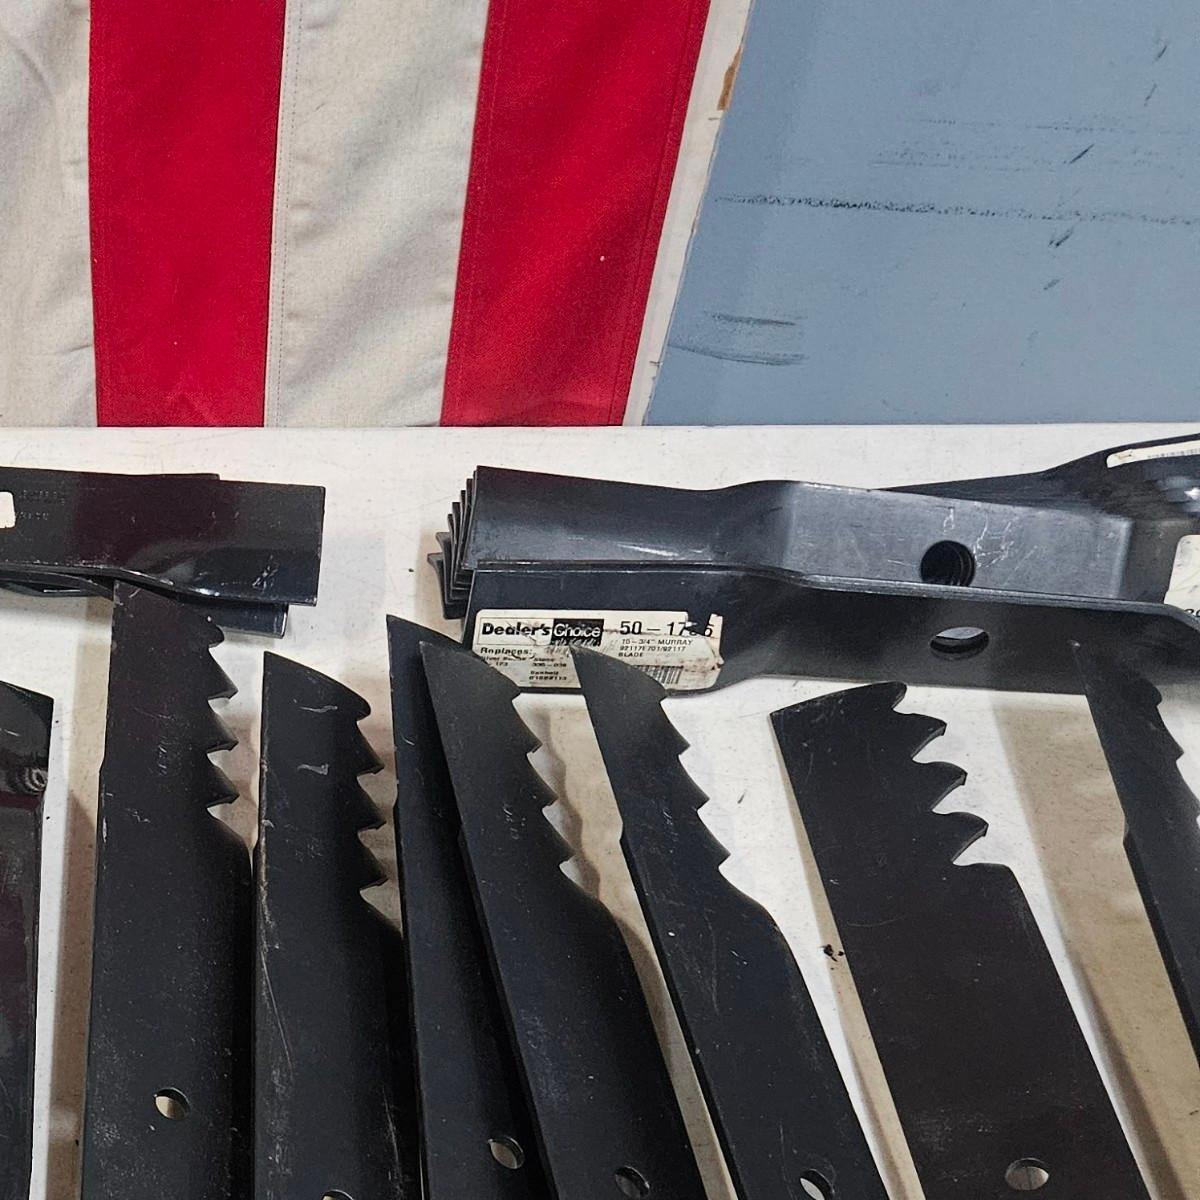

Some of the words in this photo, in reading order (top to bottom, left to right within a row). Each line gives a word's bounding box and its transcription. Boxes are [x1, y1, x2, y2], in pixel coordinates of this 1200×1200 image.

[482, 622, 552, 636] Dealer's
[553, 622, 602, 638] Choice
[619, 620, 643, 636] 50
[658, 638, 694, 646] MURRAY
